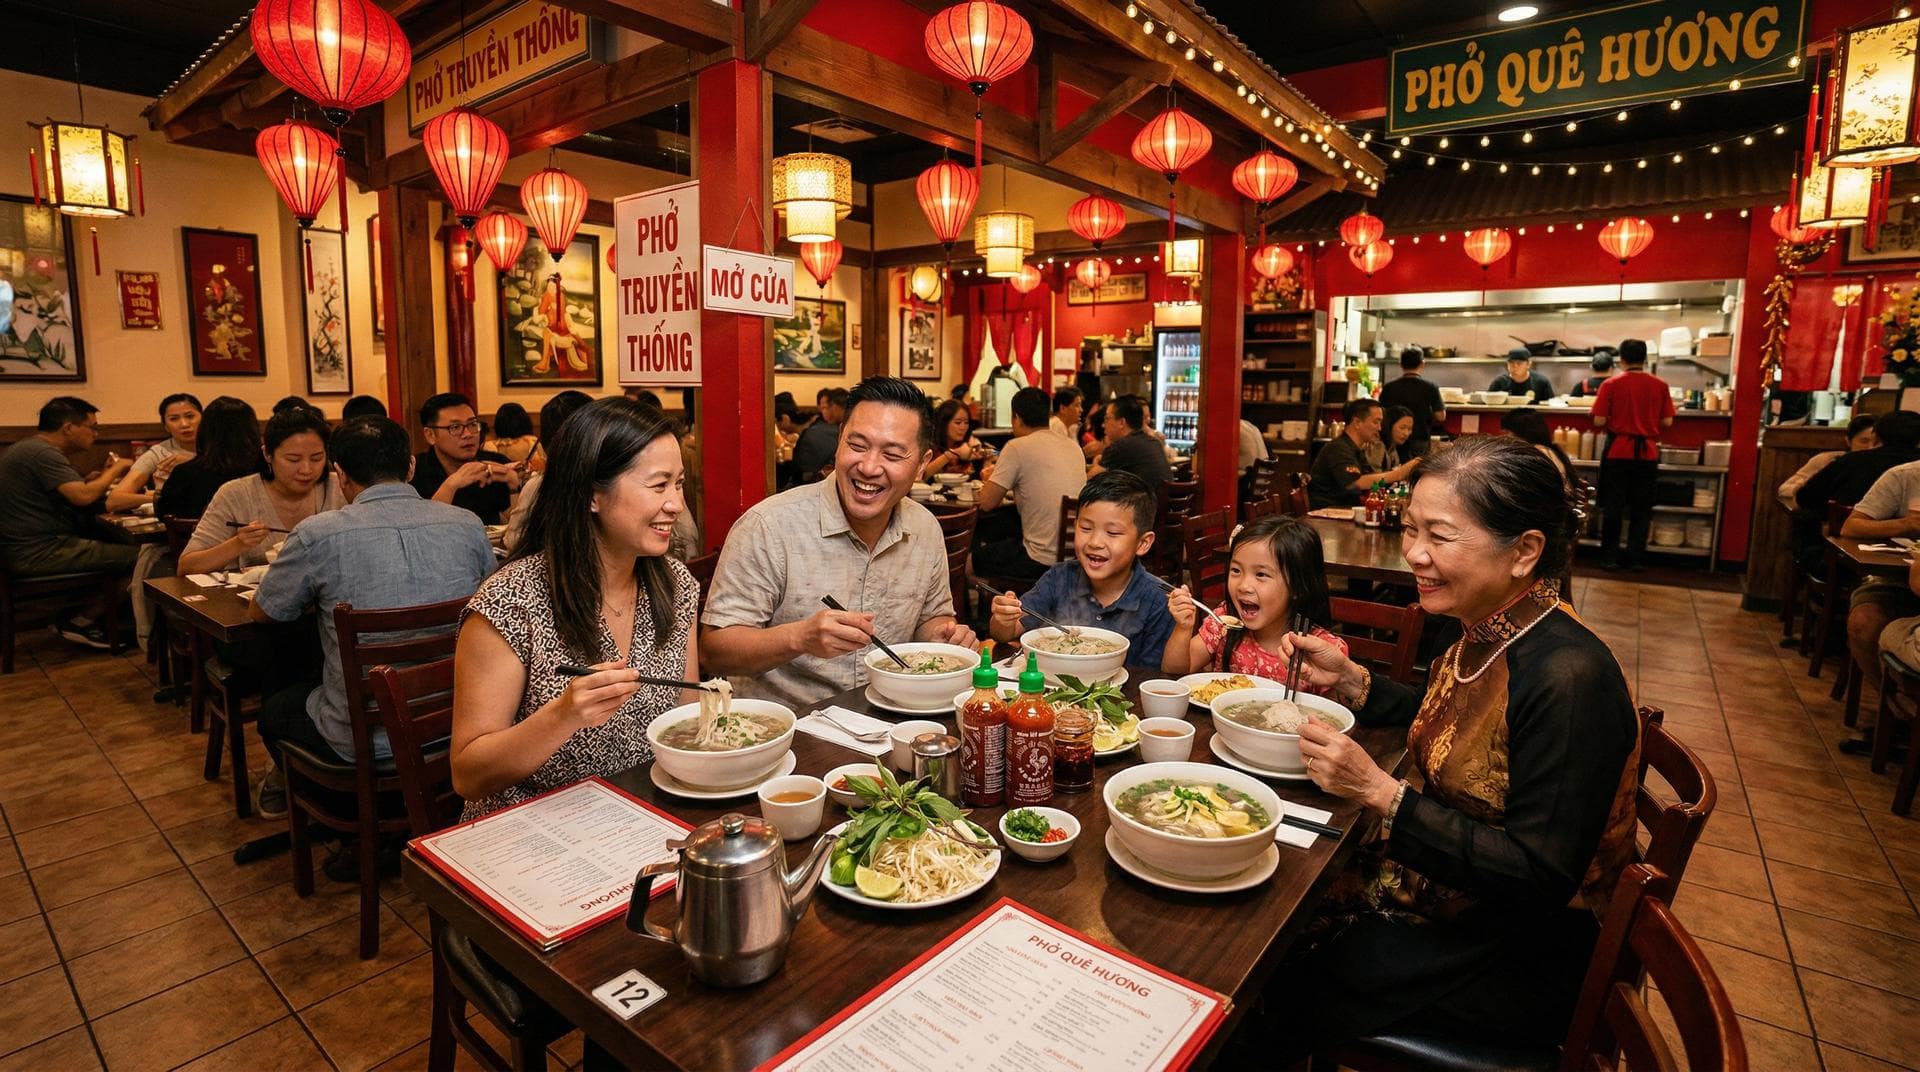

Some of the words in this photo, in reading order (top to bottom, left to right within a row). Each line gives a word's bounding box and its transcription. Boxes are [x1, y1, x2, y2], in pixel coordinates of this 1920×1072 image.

[414, 59, 445, 113] PHỞ
[446, 28, 510, 98] TRUYỀN
[513, 3, 579, 66] THỐNG
[1404, 41, 1486, 113] PHỞ
[1497, 27, 1585, 107] QUÊ
[1597, 6, 1782, 83] HƯƠNG
[637, 198, 679, 256] PHỞ
[620, 256, 698, 315] TRUYỀN
[711, 263, 745, 300] MỞ
[750, 266, 789, 305] CỬA
[626, 319, 693, 373] THỐNG
[611, 980, 649, 1009] 12
